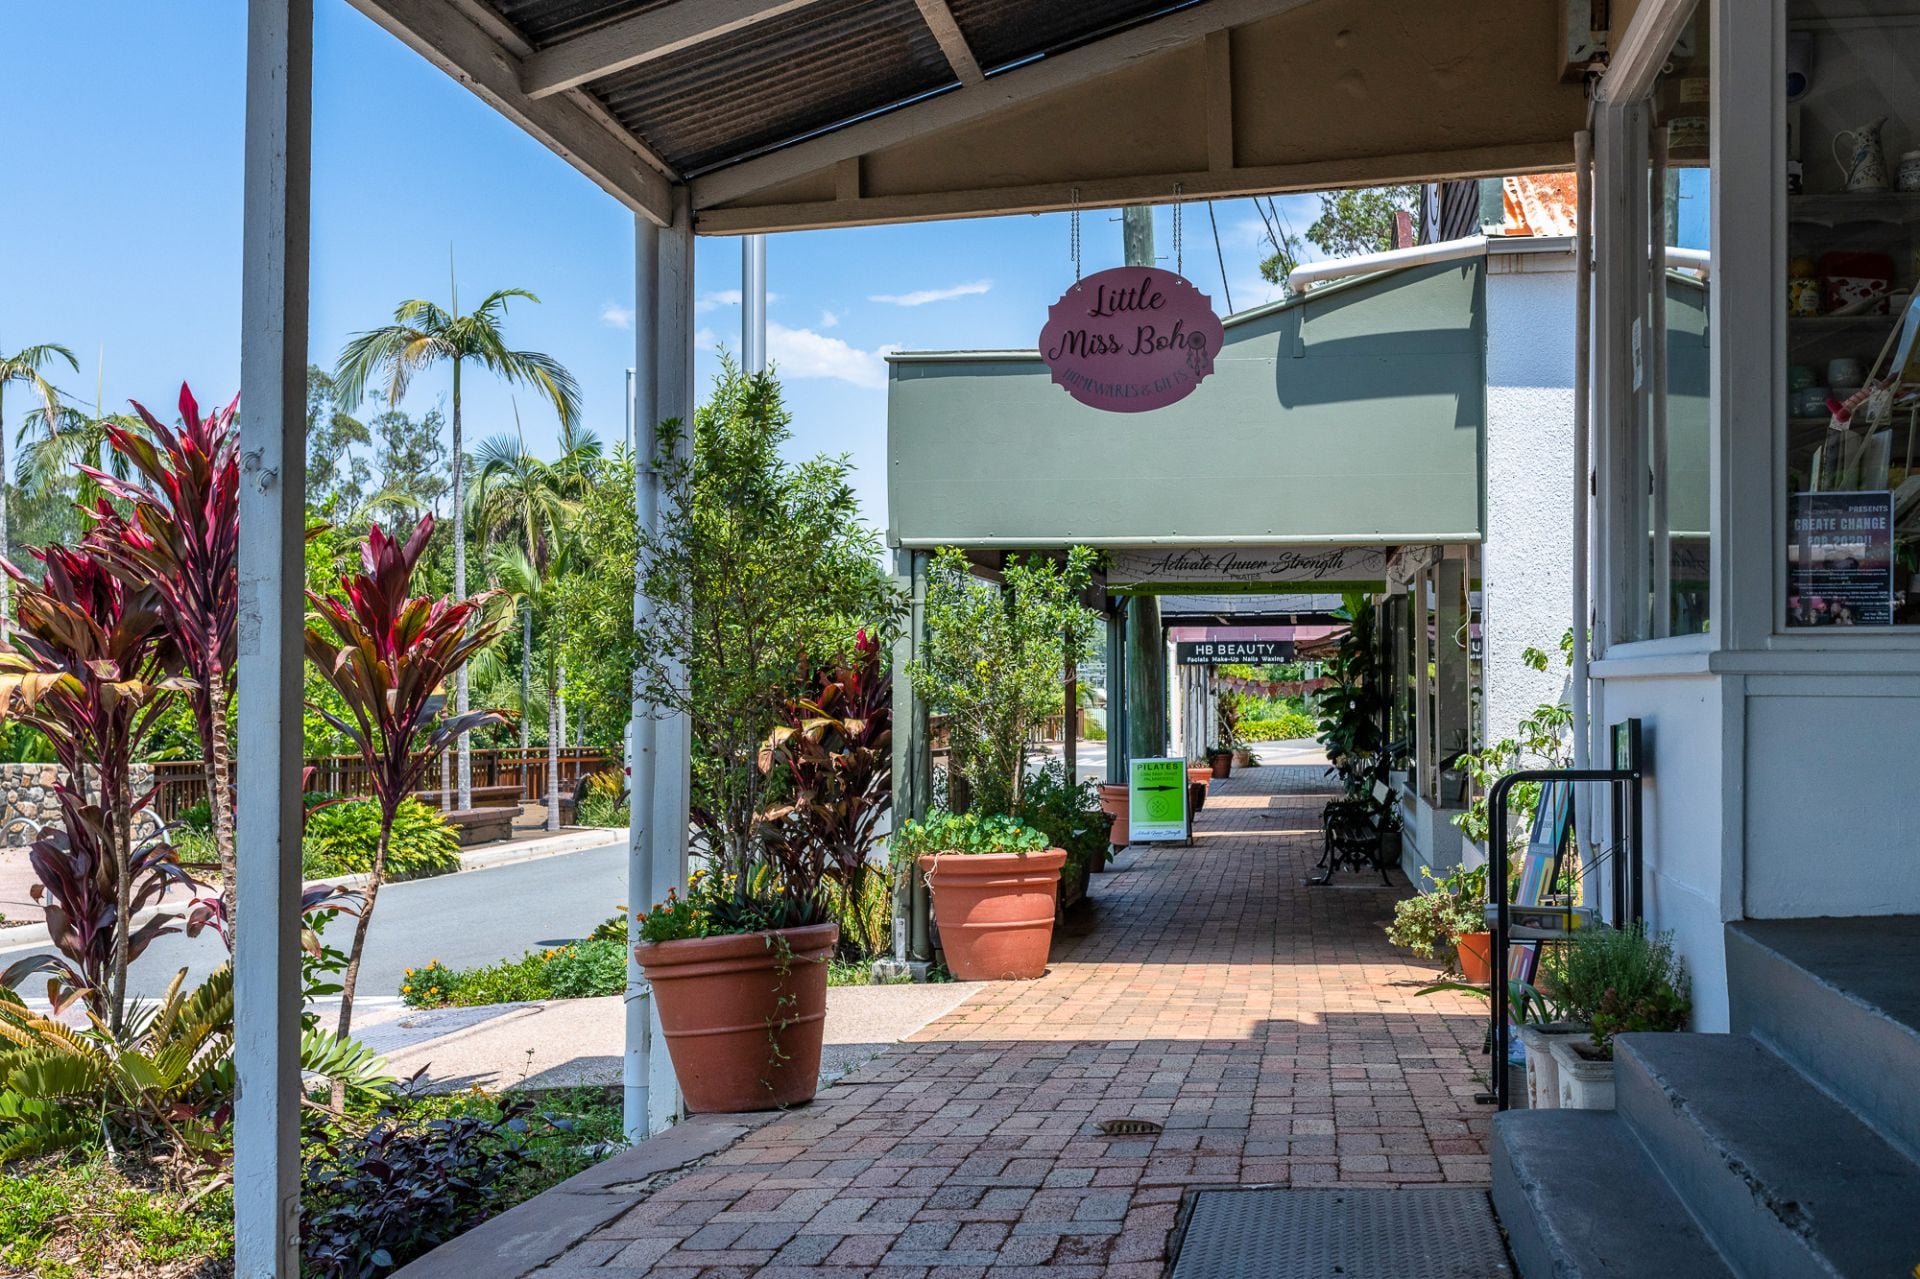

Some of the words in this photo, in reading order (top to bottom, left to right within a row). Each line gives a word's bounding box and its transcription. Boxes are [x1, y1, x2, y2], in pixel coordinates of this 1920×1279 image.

[1088, 277, 1166, 317] Little
[1048, 329, 1123, 361] Miss
[1062, 367, 1139, 398] HOMEWARES
[1155, 368, 1188, 391] GIFTS
[1794, 518, 1836, 531] CREATE
[1840, 517, 1886, 530] CHANGE
[1807, 536, 1829, 547] FOR
[1146, 552, 1214, 575] Activate
[1215, 551, 1267, 574] Inner
[1271, 551, 1343, 579] Strength
[1195, 645, 1213, 655] HB
[1217, 644, 1275, 655] BEAUTY
[1261, 655, 1285, 663] Waxing
[1137, 763, 1179, 771] PILATES
